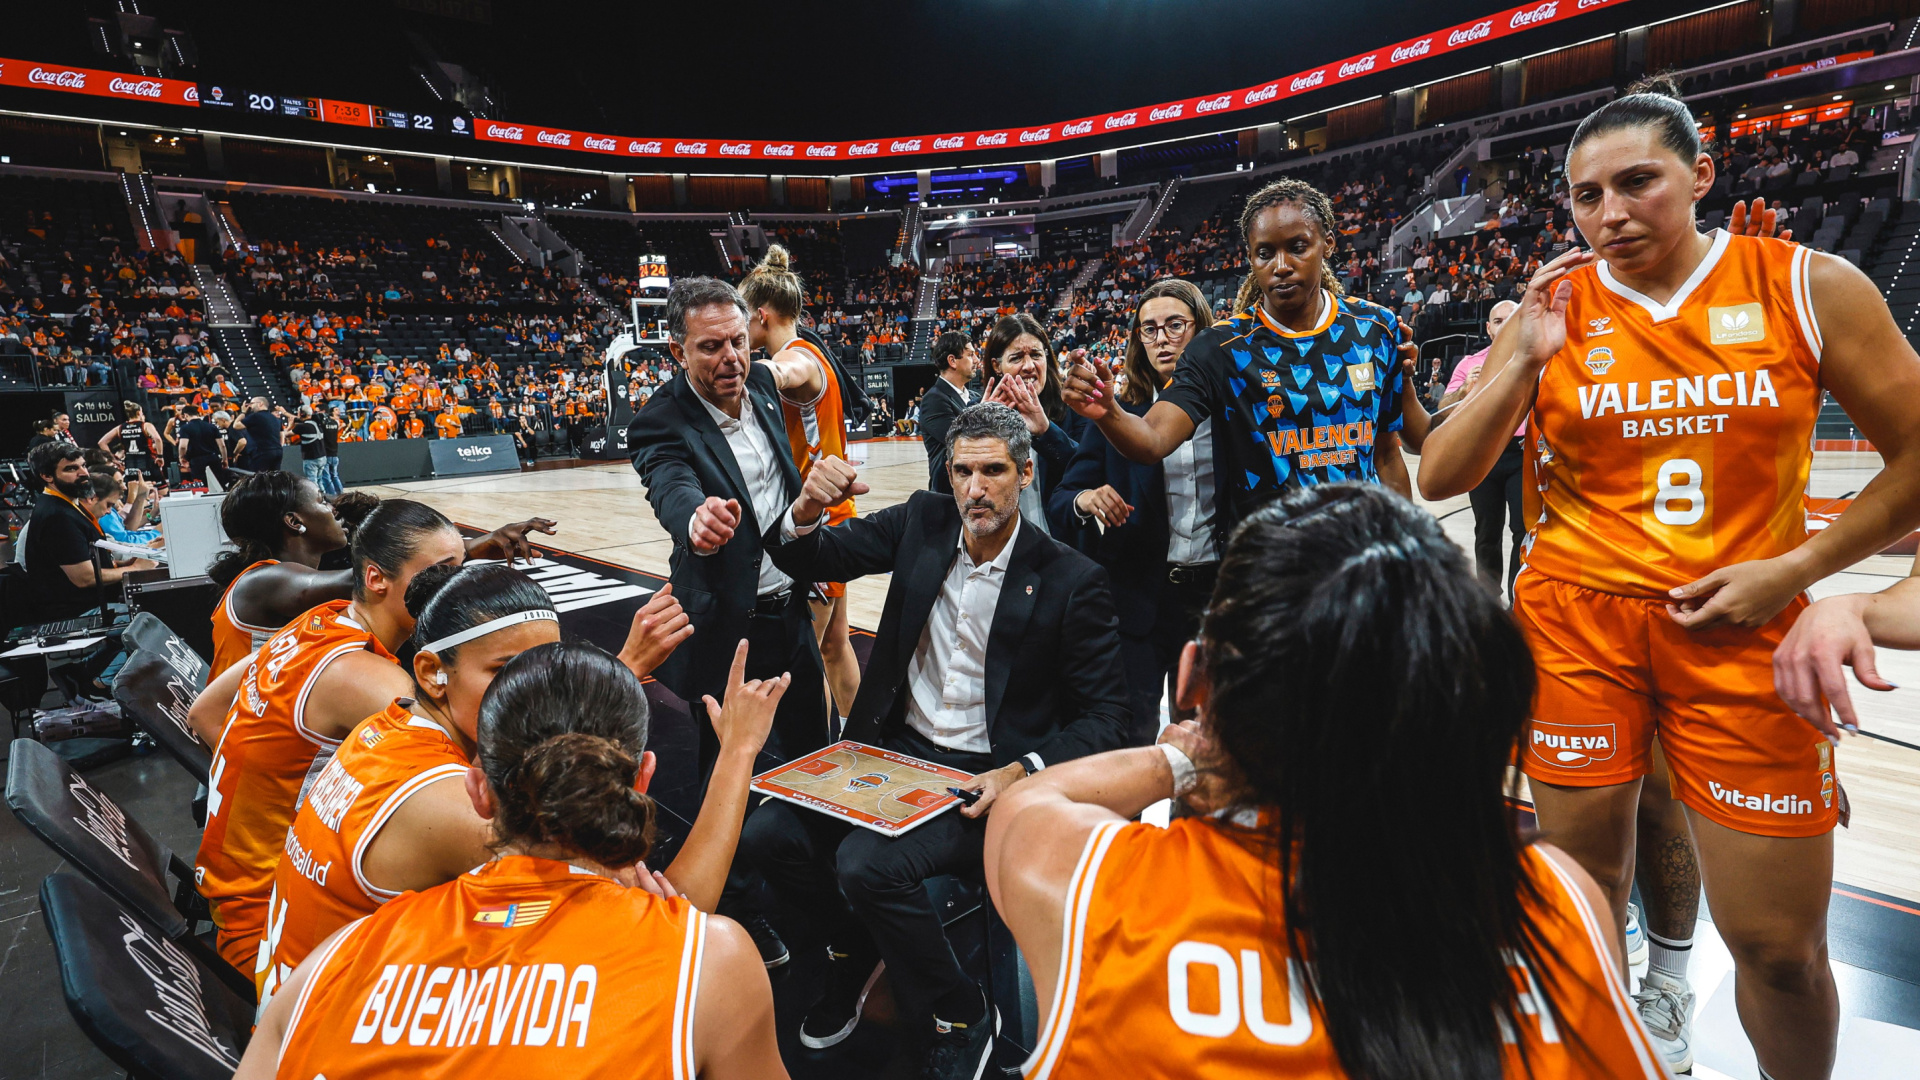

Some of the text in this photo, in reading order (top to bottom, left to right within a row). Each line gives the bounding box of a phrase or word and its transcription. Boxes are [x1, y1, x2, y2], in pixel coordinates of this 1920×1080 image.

[1510, 1, 1559, 29] Coca-Cola
[1448, 20, 1493, 47] Coca-Cola
[1391, 38, 1433, 63] Coca-Cola
[1338, 54, 1377, 78] Coca-Cola
[28, 67, 87, 89] Coca-Cola
[109, 77, 163, 98] Coca-Cola
[1290, 70, 1326, 92] Coca-Cola
[249, 94, 275, 111] 20
[332, 104, 361, 117] 7:36
[413, 114, 434, 130] 22
[650, 263, 667, 277] 24
[1577, 369, 1779, 420] VALENCIA
[76, 412, 116, 423] SALIDA
[1622, 414, 1729, 439] BASKET
[1266, 420, 1374, 457] VALENCIA
[456, 445, 493, 457] teika
[1298, 449, 1358, 469] BASKET
[1653, 457, 1705, 526] 8
[1533, 729, 1610, 751] PULEVA
[792, 792, 848, 815] VALENCIA
[1709, 780, 1812, 815] vitaldin
[351, 962, 597, 1048] BUENAVIDA
